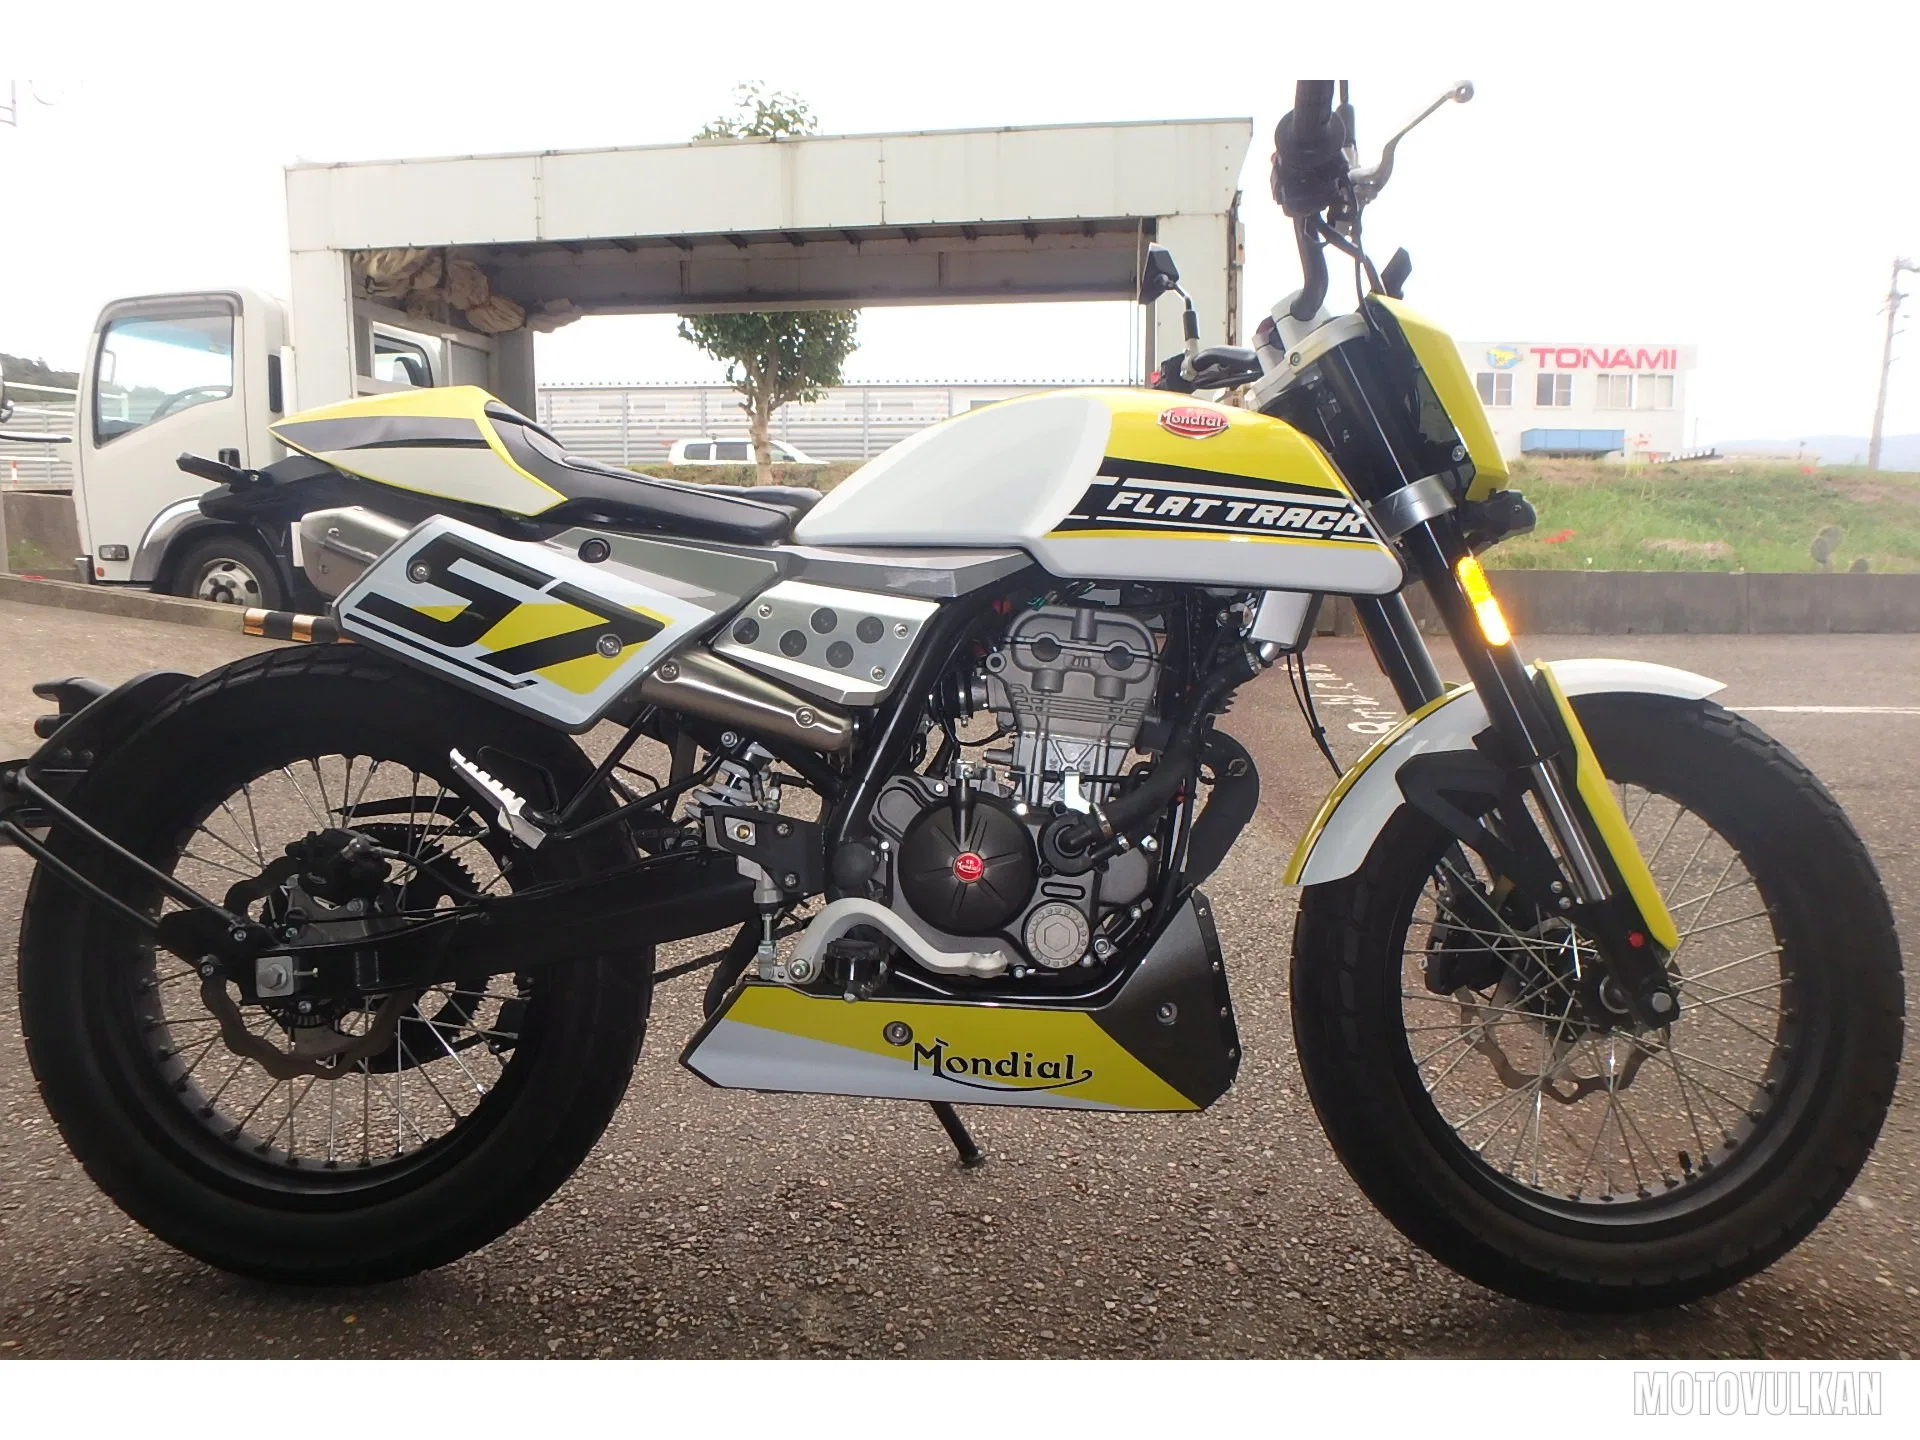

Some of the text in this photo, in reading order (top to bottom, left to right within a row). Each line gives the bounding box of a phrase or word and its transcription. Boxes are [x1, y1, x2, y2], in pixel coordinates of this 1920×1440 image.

[1530, 347, 1680, 370] TONAMI
[1157, 409, 1230, 432] Mondial
[1106, 491, 1366, 534] FLAT TRACK
[913, 1037, 1093, 1092] Mondial
